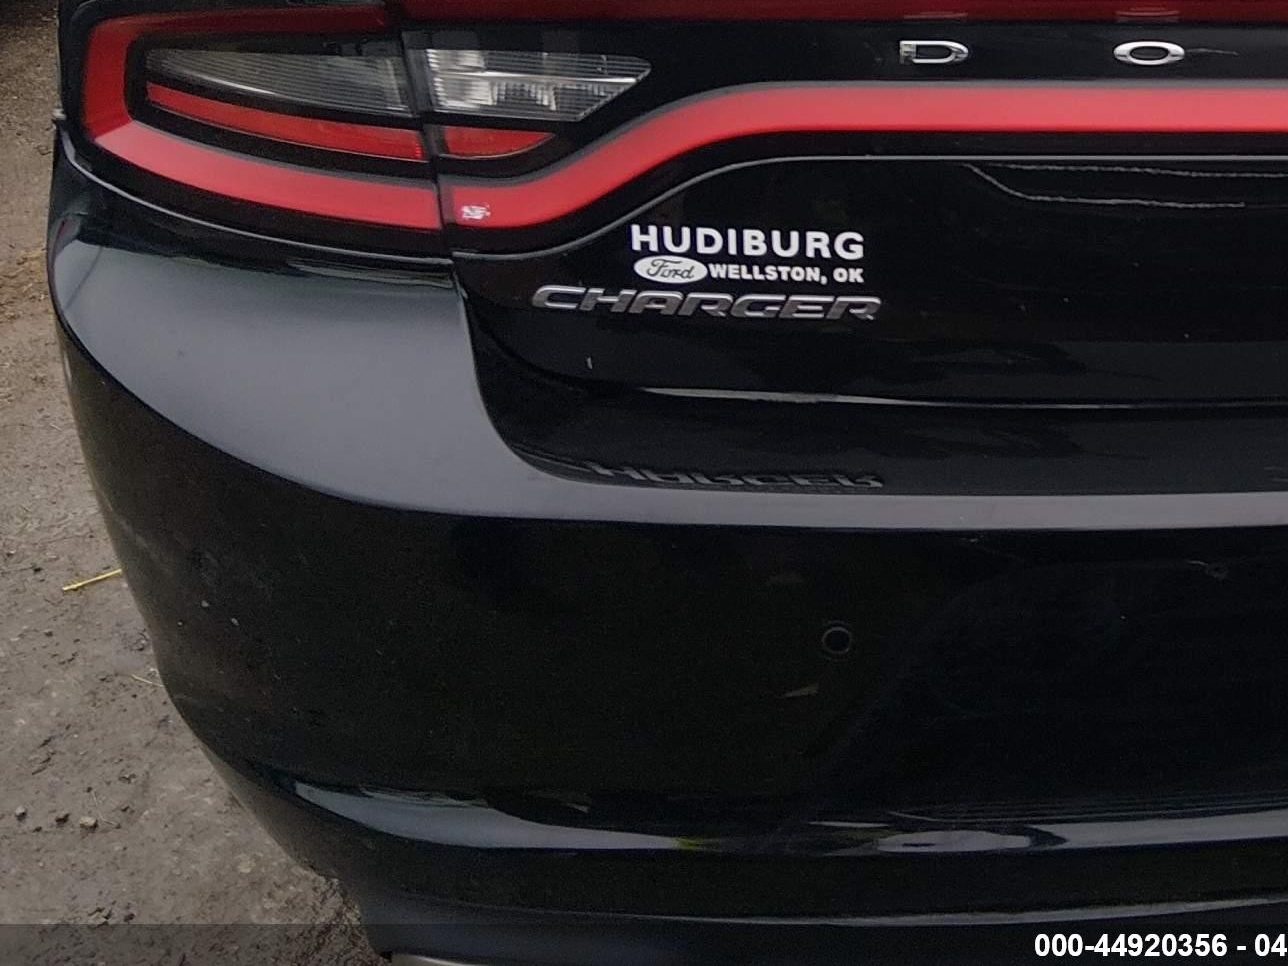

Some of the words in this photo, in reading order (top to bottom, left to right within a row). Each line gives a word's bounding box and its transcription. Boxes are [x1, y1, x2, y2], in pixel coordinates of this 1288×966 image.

[631, 224, 864, 261] HUDIBURG
[646, 258, 695, 280] Ford
[707, 263, 828, 285] WELLSTON,
[833, 266, 864, 284] OK
[531, 285, 882, 321] CHARGER
